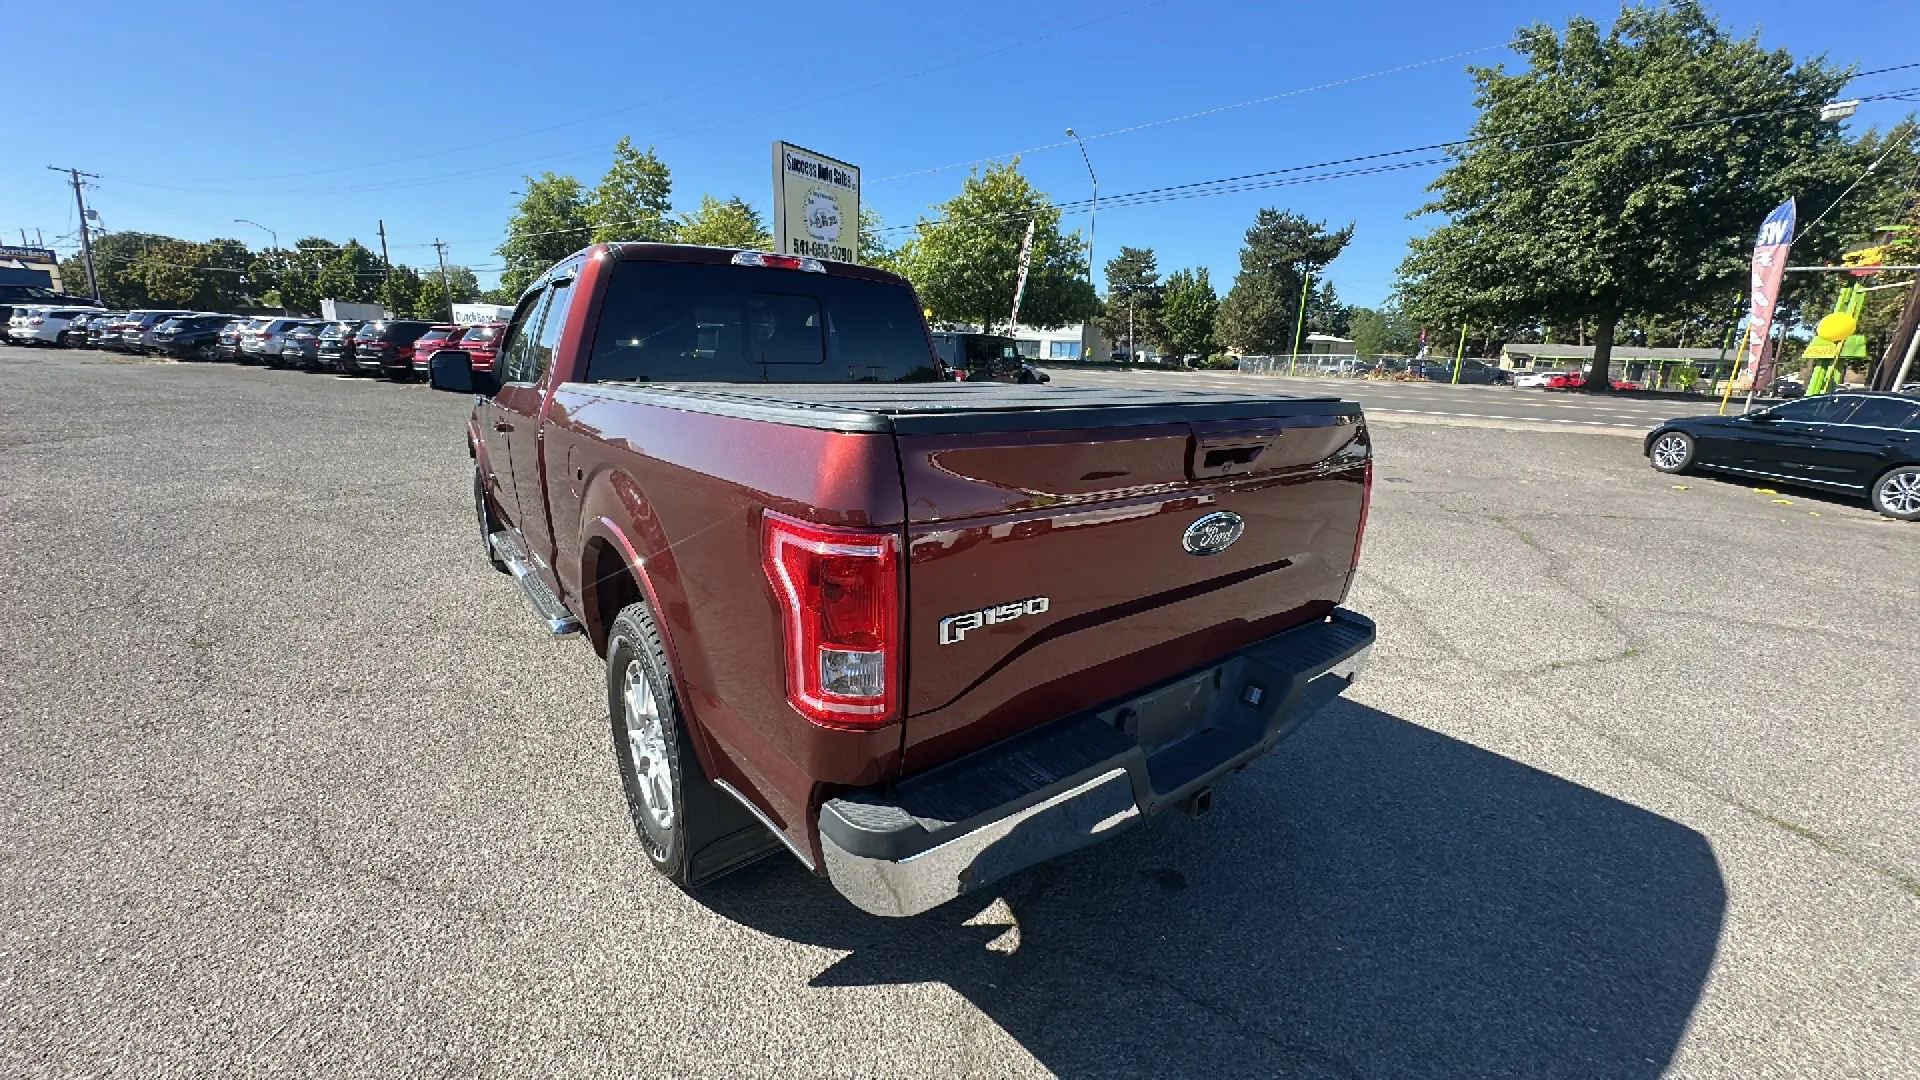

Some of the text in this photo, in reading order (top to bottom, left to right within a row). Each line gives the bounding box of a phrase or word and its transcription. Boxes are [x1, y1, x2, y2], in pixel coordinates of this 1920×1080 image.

[786, 153, 852, 188] Success Auto Sales
